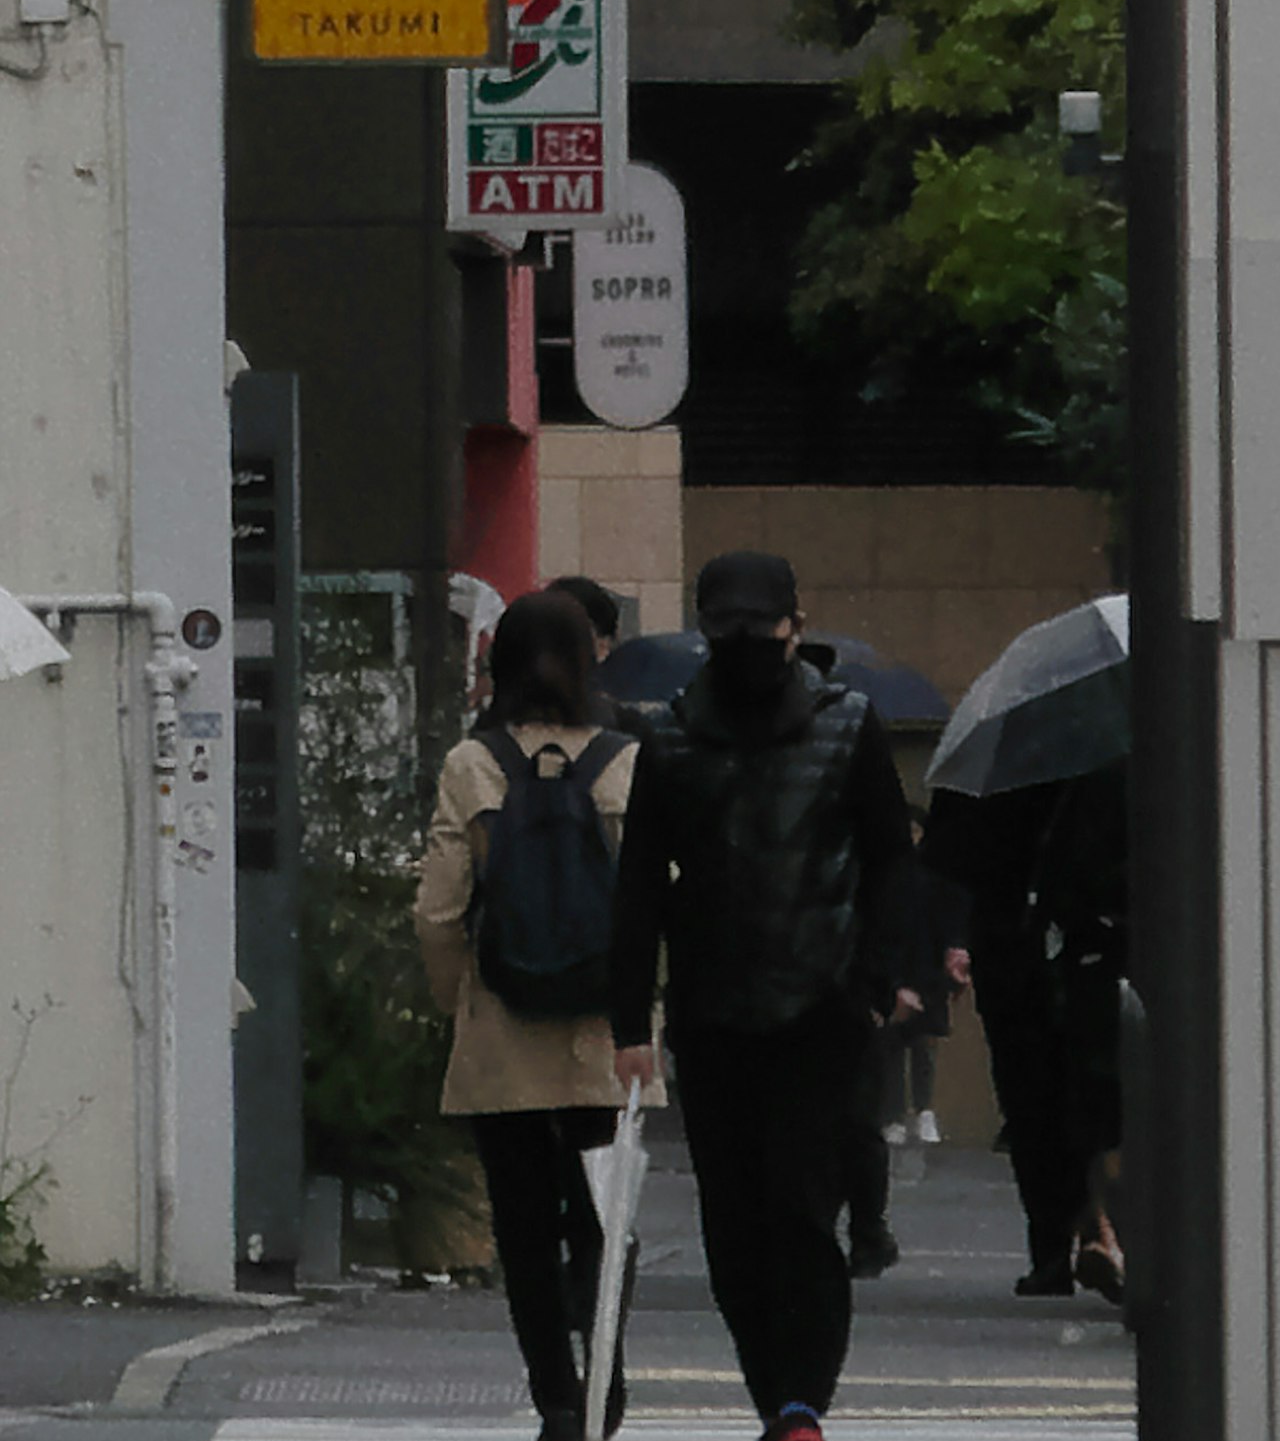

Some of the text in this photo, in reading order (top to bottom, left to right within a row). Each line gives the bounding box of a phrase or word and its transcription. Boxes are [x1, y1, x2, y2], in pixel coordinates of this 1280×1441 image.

[298, 11, 441, 37] TAKUMI
[482, 126, 597, 164] 酒 たばこ
[480, 173, 595, 211] ATM
[591, 276, 672, 301] SOPRA
